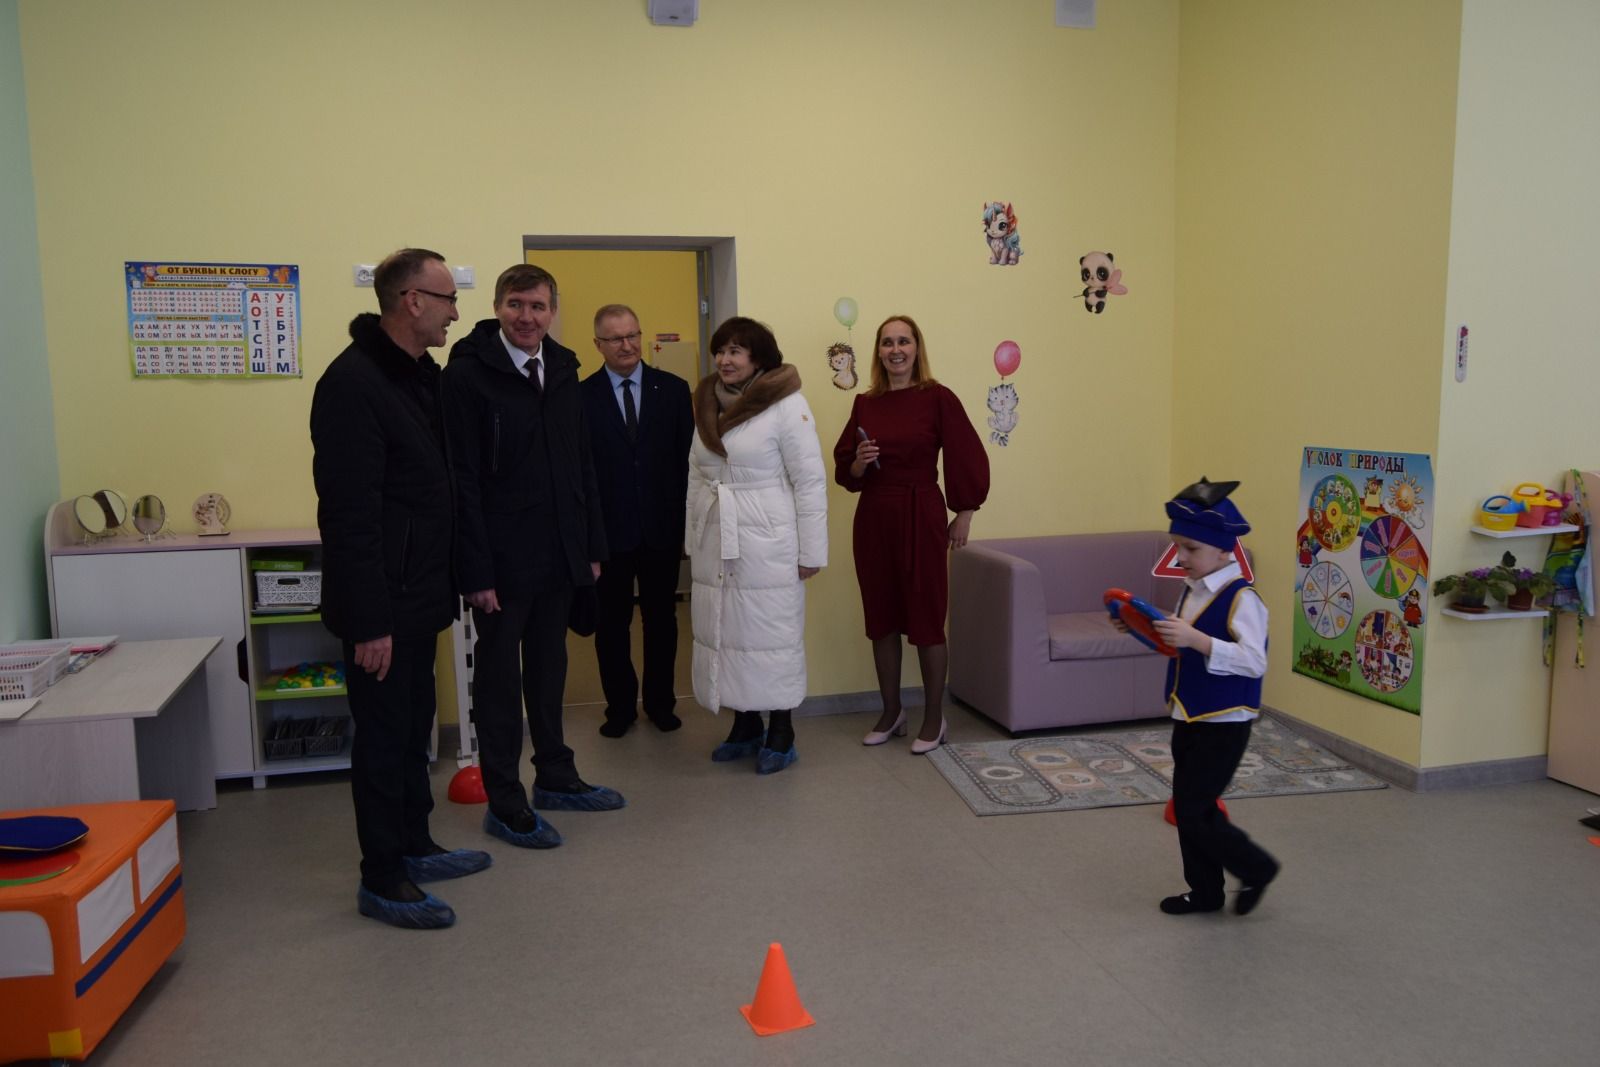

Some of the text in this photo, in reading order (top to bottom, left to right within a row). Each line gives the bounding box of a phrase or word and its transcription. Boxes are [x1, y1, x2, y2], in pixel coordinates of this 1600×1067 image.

[167, 266, 259, 276] ОТ БУКВЫ К СЛОГУ
[250, 292, 261, 303] А
[275, 293, 285, 303] У
[251, 306, 261, 317] О
[276, 307, 284, 317] Е
[252, 320, 261, 331] Т
[277, 320, 286, 331] Б
[253, 334, 263, 344] С
[277, 334, 286, 345] Р
[252, 348, 263, 358] Л
[278, 348, 285, 359] Г
[252, 362, 265, 373] Ш
[276, 362, 290, 373] М
[1306, 449, 1404, 474] УГОЛОК ПРИРОДЫ
